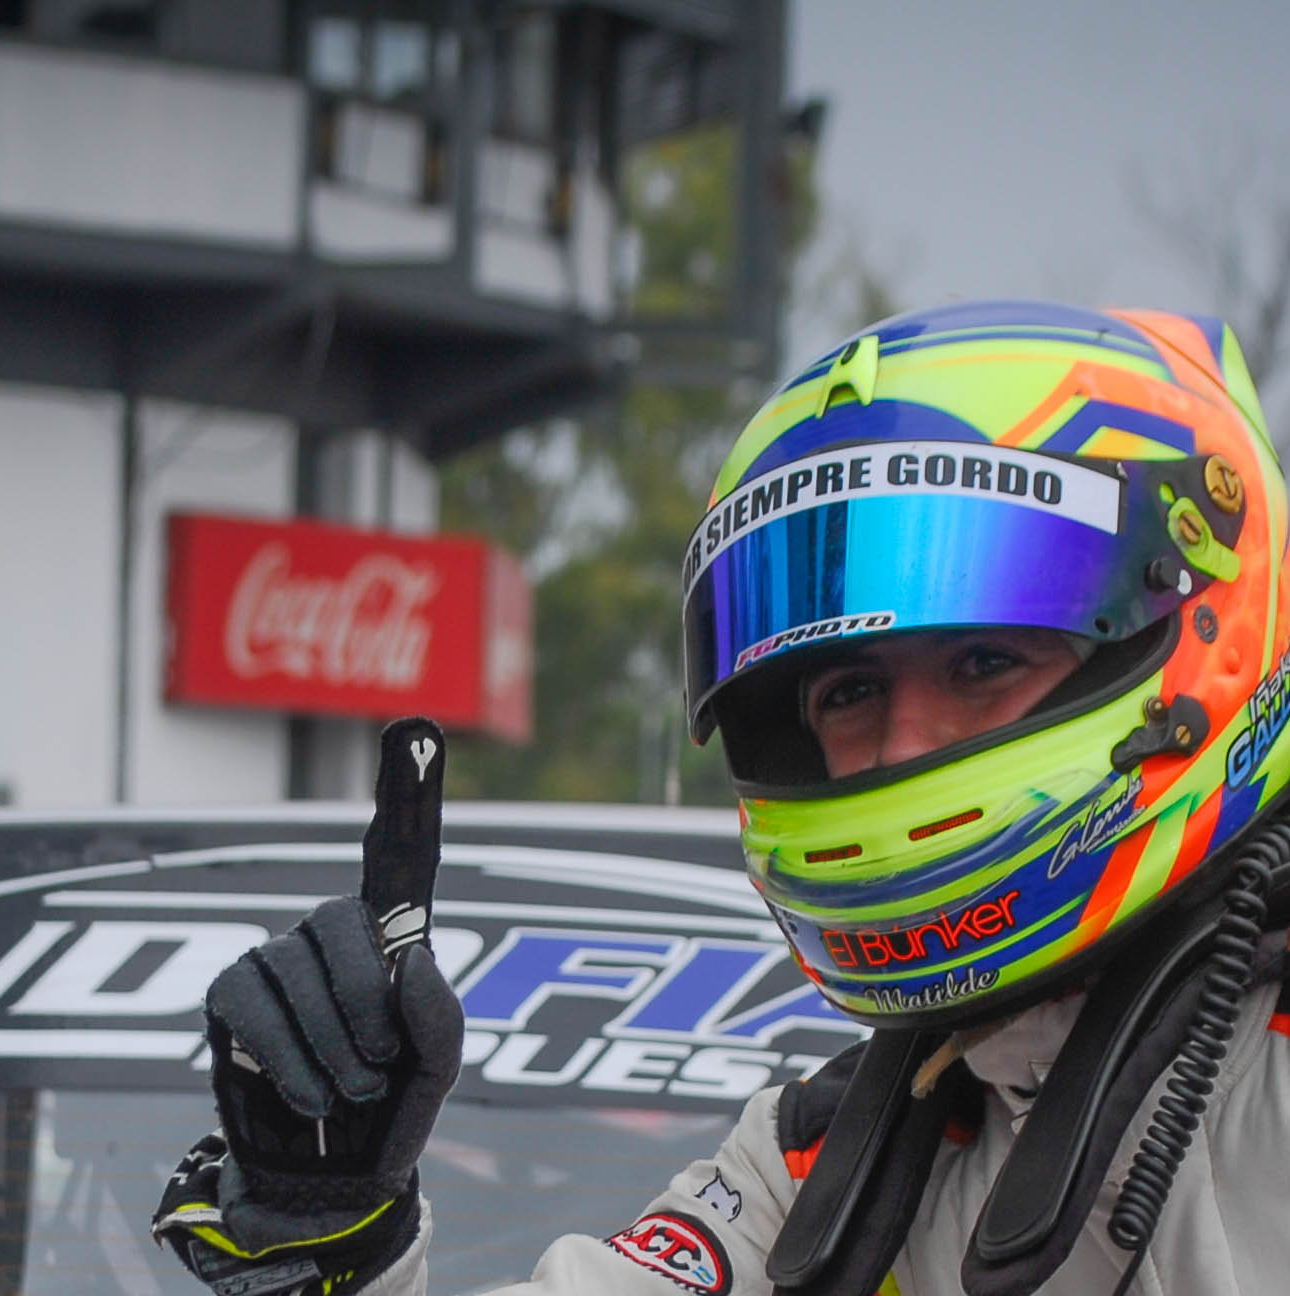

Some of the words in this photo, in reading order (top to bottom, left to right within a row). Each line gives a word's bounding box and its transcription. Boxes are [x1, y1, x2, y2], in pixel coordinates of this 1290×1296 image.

[707, 456, 872, 555] SIEMPRE
[887, 454, 1062, 505] GORDO
[864, 967, 1000, 1012] Matilde
